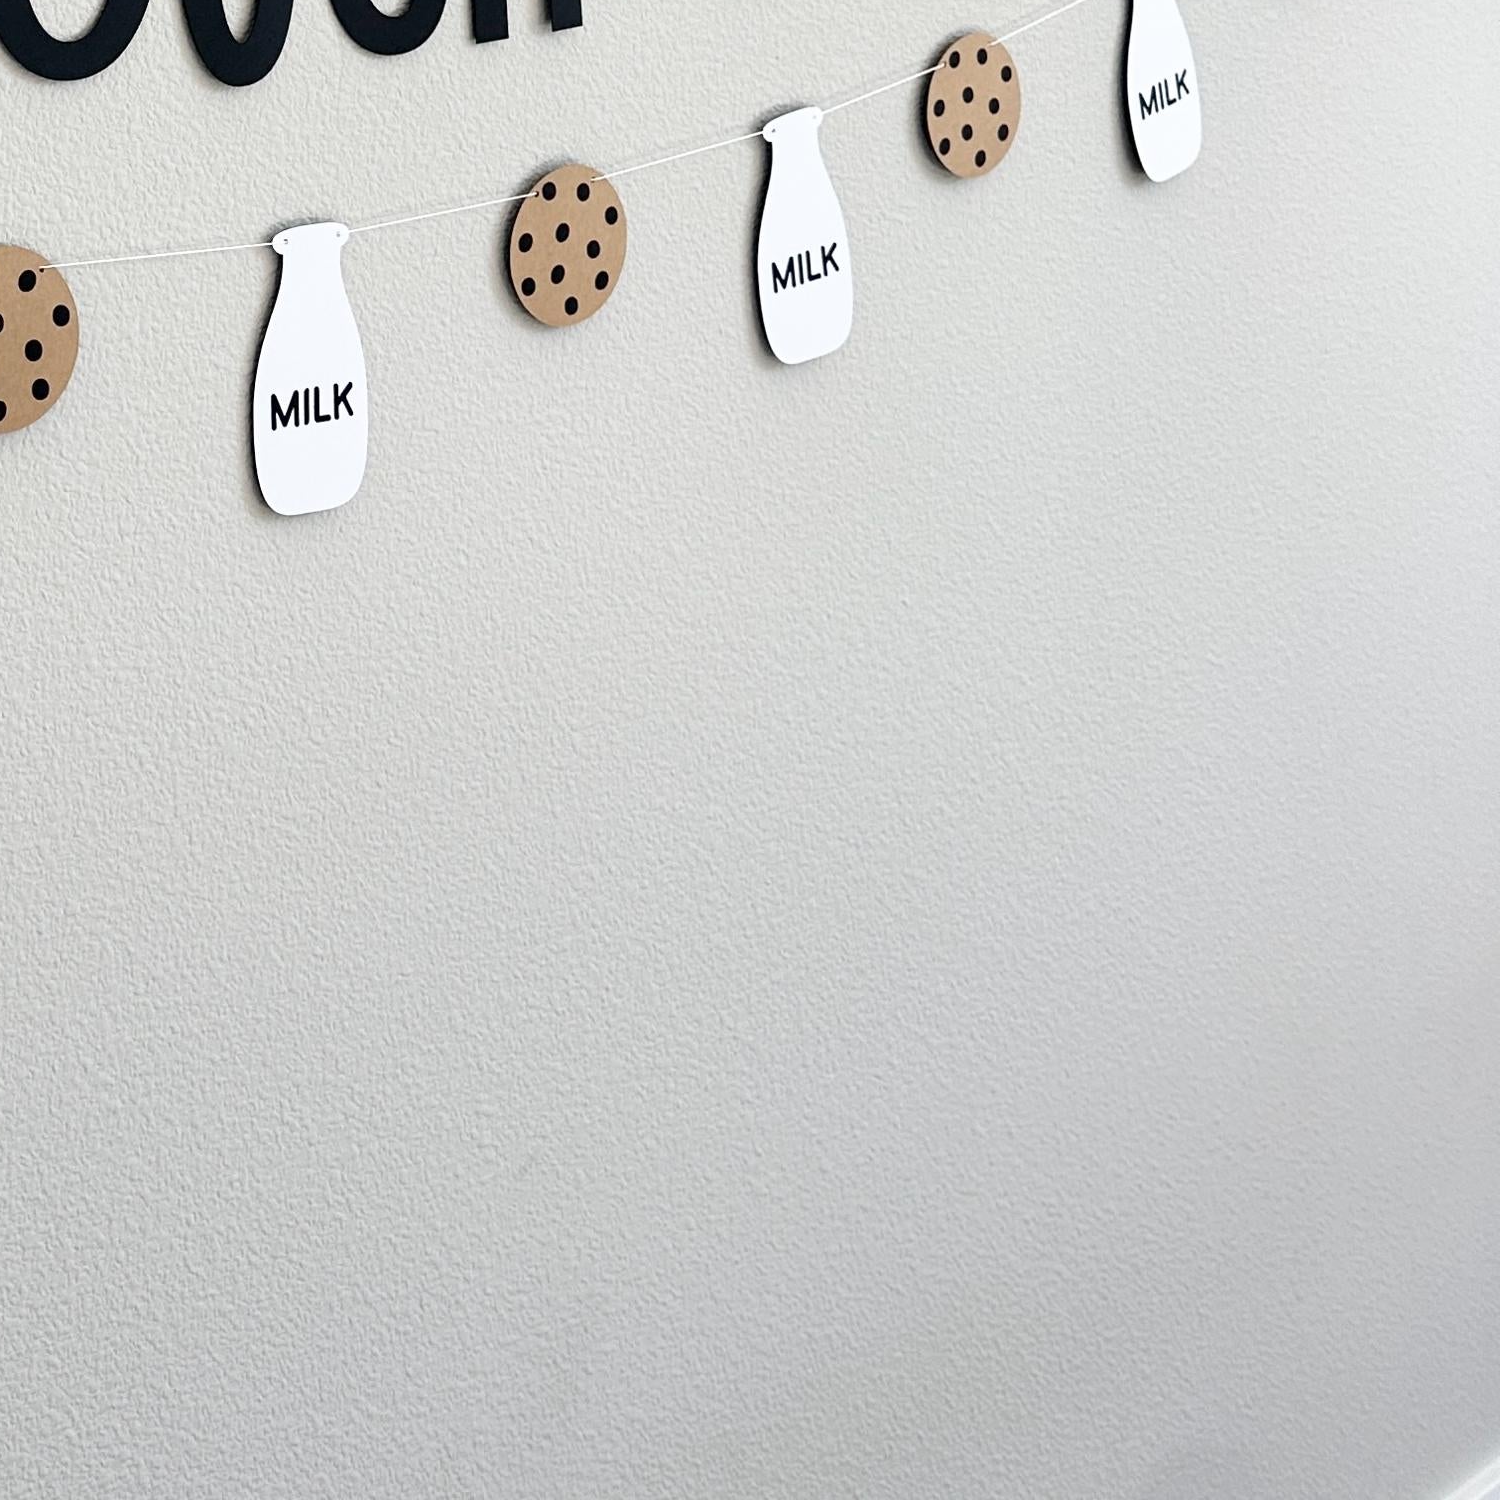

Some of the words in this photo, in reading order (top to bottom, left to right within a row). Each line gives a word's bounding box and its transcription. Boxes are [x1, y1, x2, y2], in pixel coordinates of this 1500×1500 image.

[1137, 69, 1191, 121] MILK
[770, 241, 840, 294] MILK
[269, 380, 356, 432] MILK
